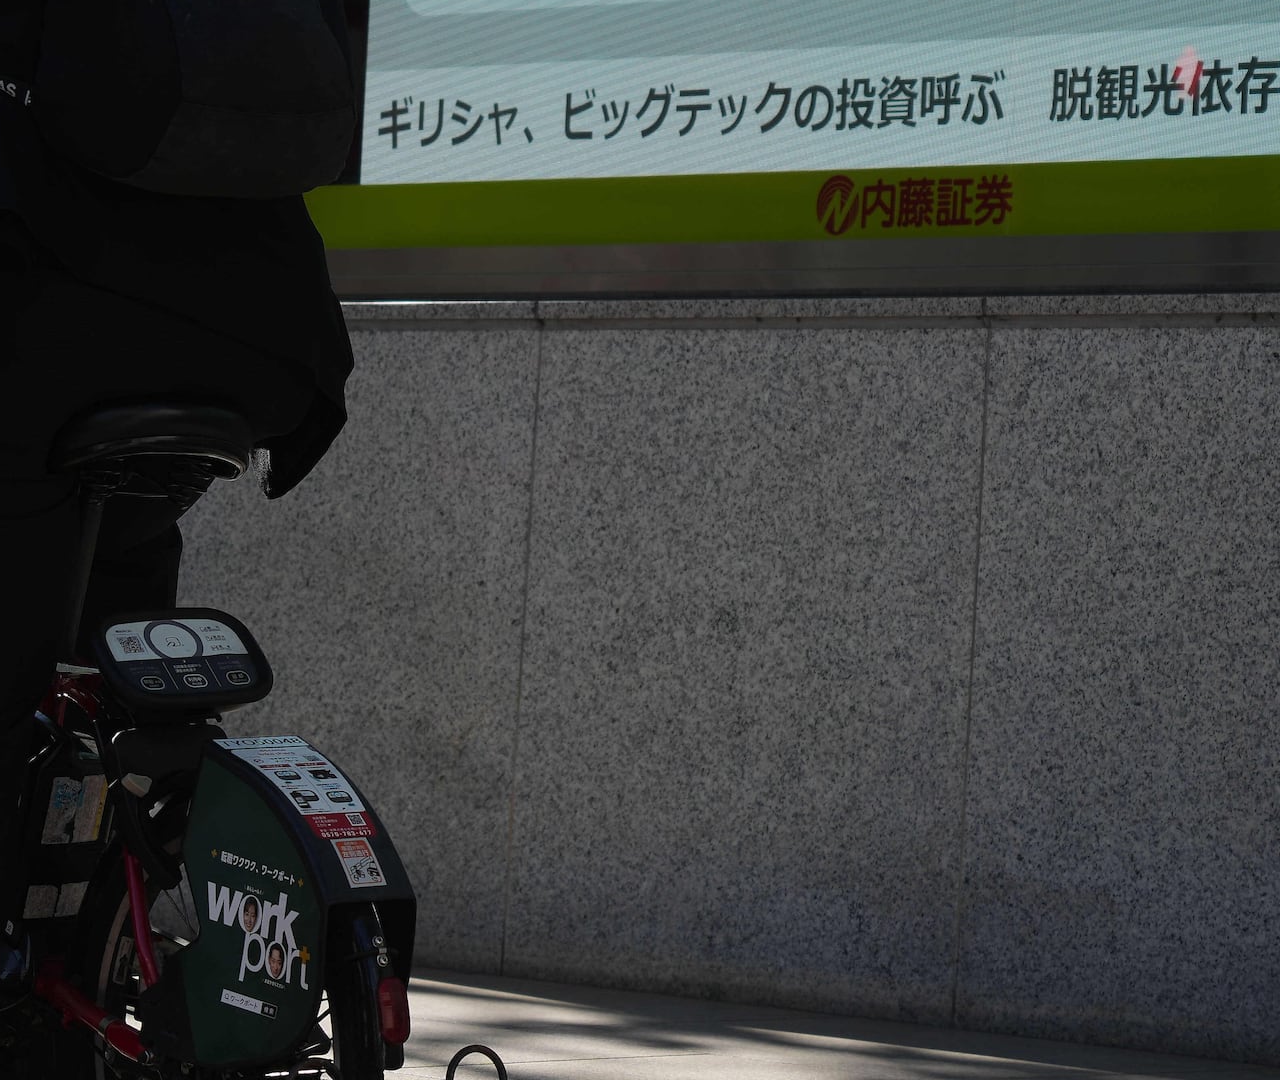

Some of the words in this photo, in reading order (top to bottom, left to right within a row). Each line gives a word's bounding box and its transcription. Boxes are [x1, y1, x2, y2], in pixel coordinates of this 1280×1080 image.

[377, 70, 1007, 150] ギリシャ、ビッグテックの投資呼ぶ
[860, 174, 1014, 230] 内藤証券
[207, 880, 300, 950] work
